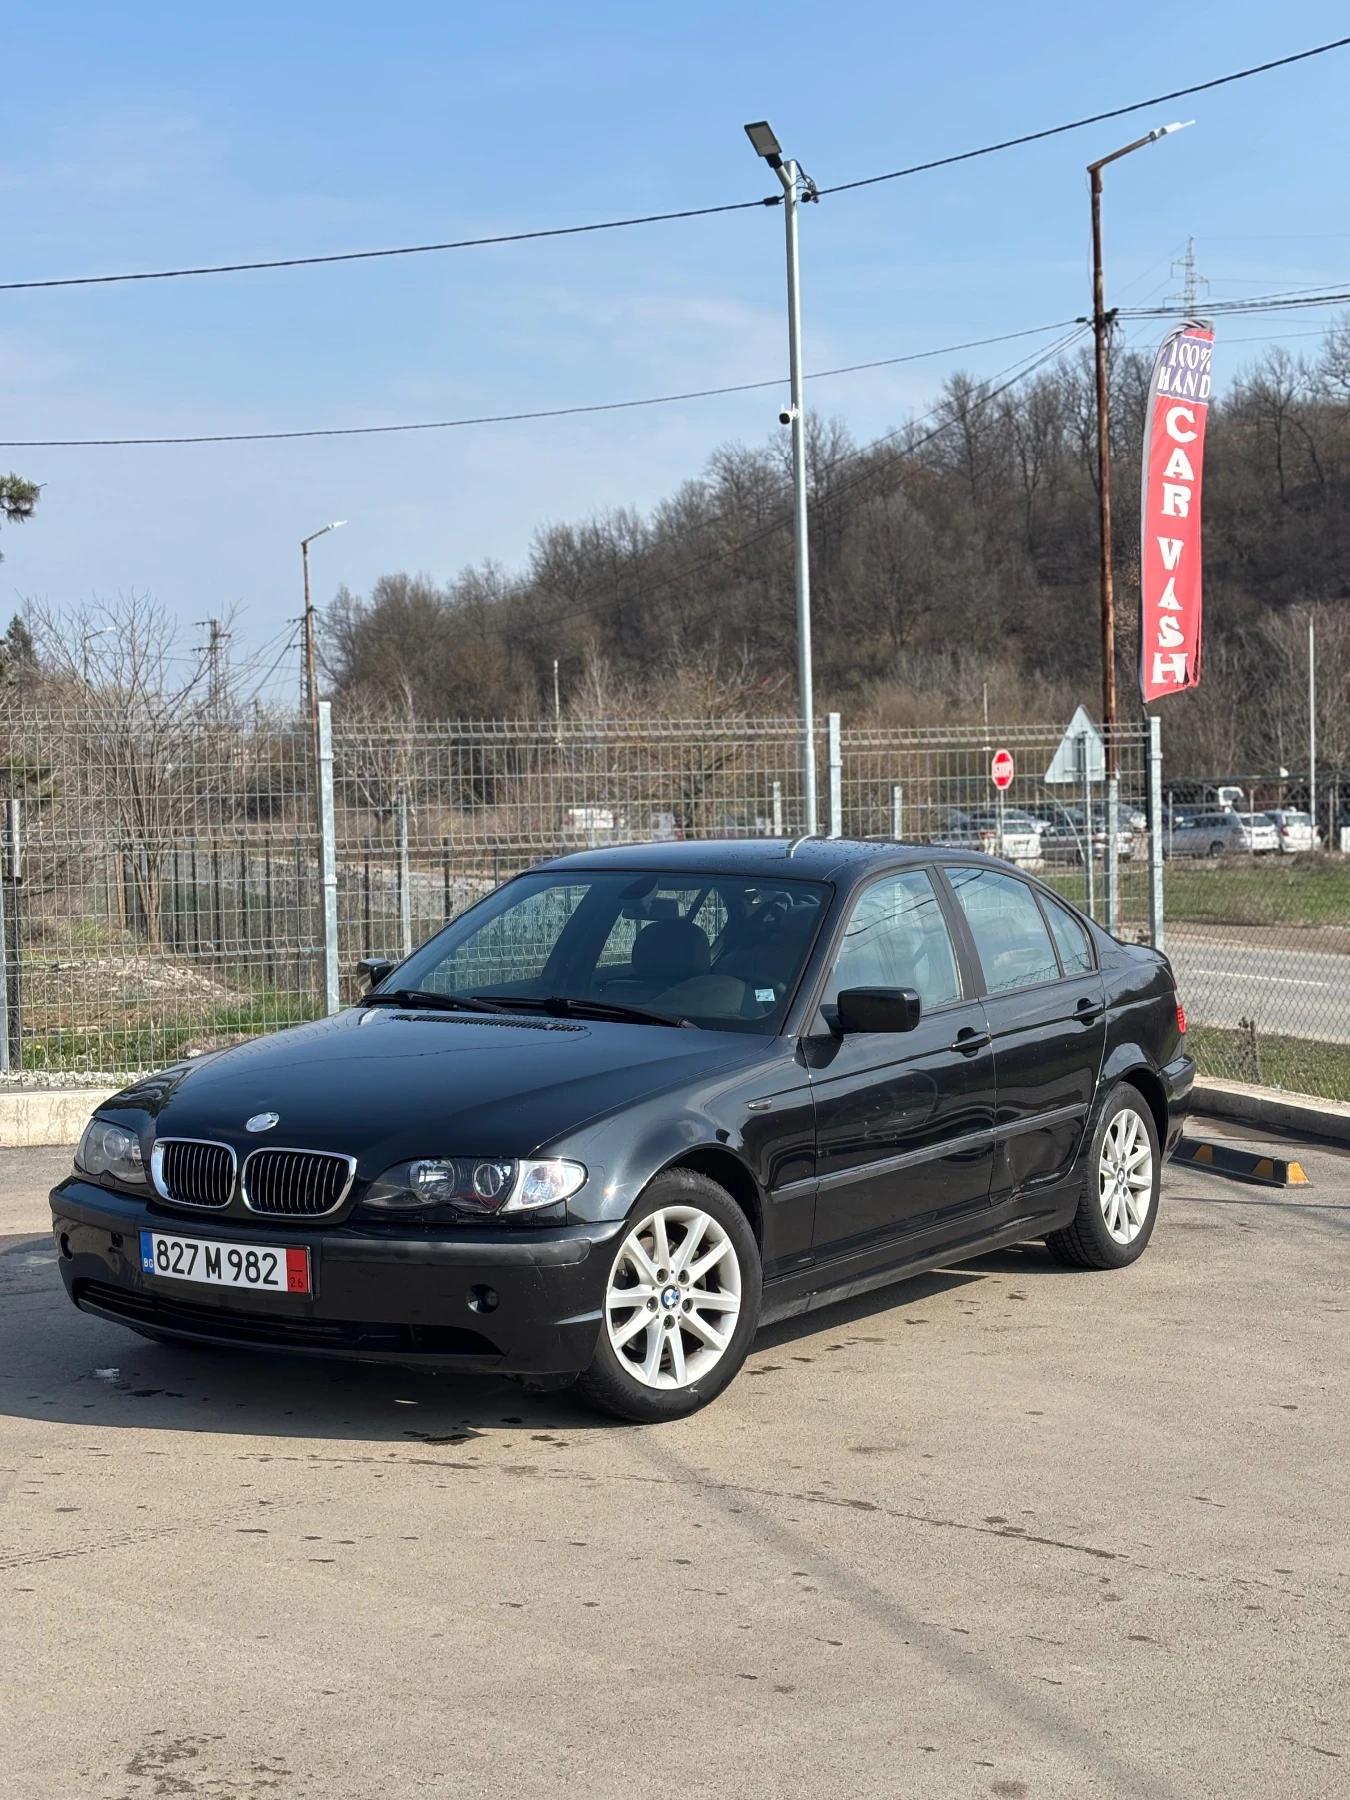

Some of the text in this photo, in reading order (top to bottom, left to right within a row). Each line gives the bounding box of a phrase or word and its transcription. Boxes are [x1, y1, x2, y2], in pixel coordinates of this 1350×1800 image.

[1169, 341, 1212, 373] 100%
[1157, 365, 1211, 399] HAND
[1151, 406, 1197, 684] CAR WASH
[993, 761, 1012, 778] STOP
[143, 1257, 154, 1269] BG
[156, 1239, 278, 1285] 827 M 982
[290, 1276, 304, 1289] 26
